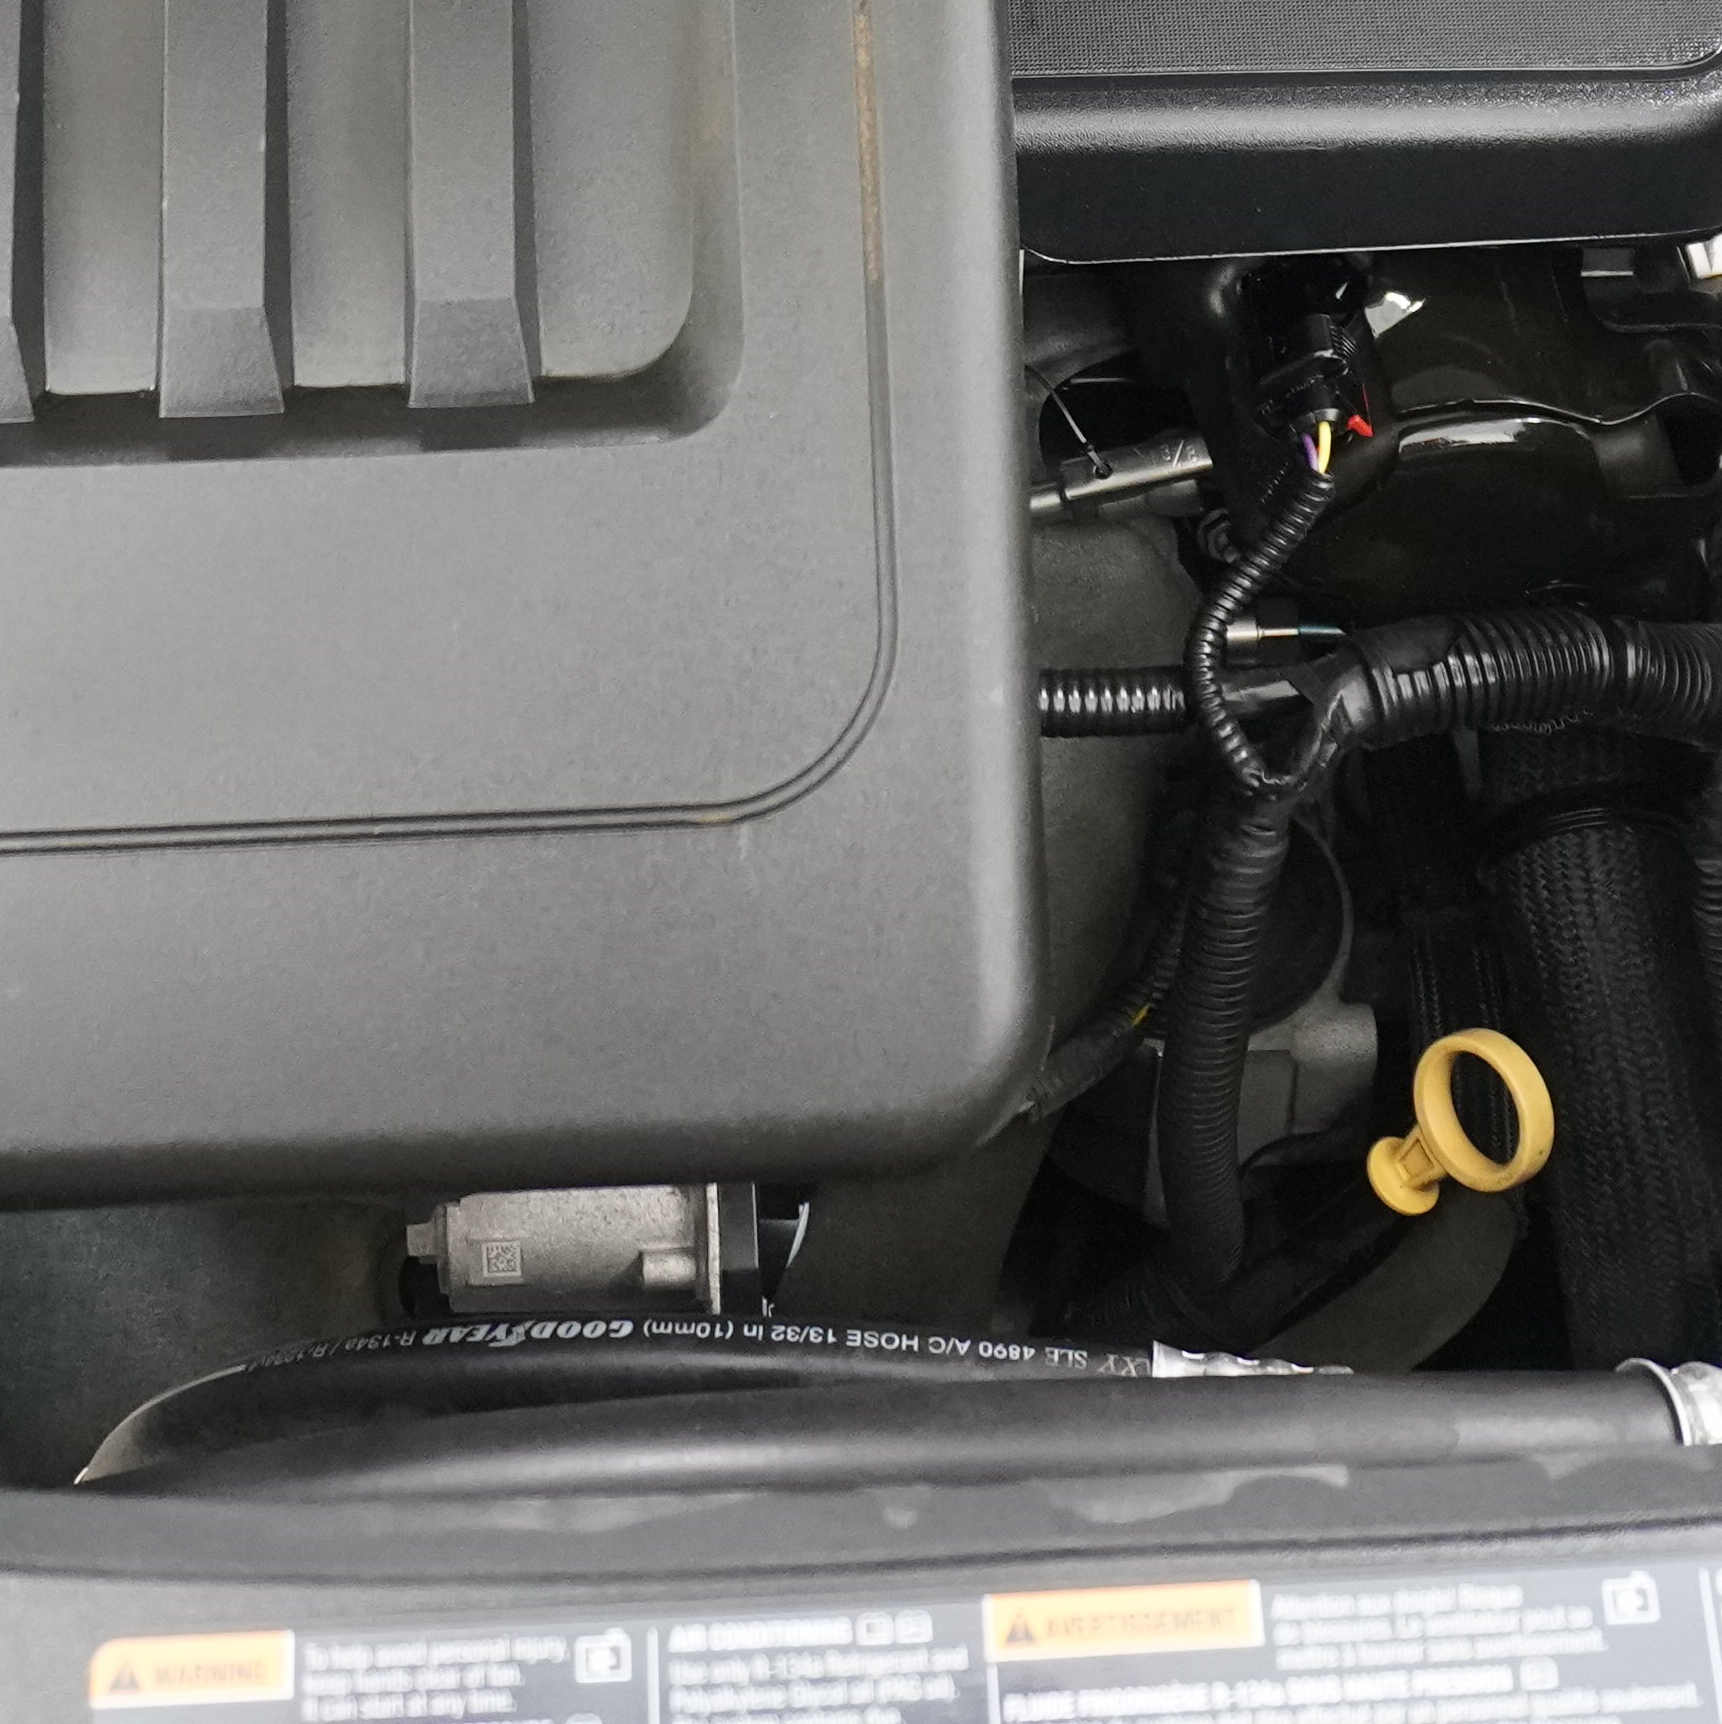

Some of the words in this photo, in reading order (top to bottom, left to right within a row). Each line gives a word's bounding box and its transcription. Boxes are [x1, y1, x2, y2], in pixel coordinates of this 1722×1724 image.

[421, 1319, 635, 1348] GOODYEAR
[643, 1320, 734, 1339] (10mm)
[770, 1325, 837, 1345] 13/32
[845, 1328, 919, 1351] HOSE
[928, 1334, 971, 1357] A/C
[979, 1340, 1036, 1360] 4890
[1045, 1347, 1087, 1370] SLE
[153, 1661, 266, 1684] WARNING
